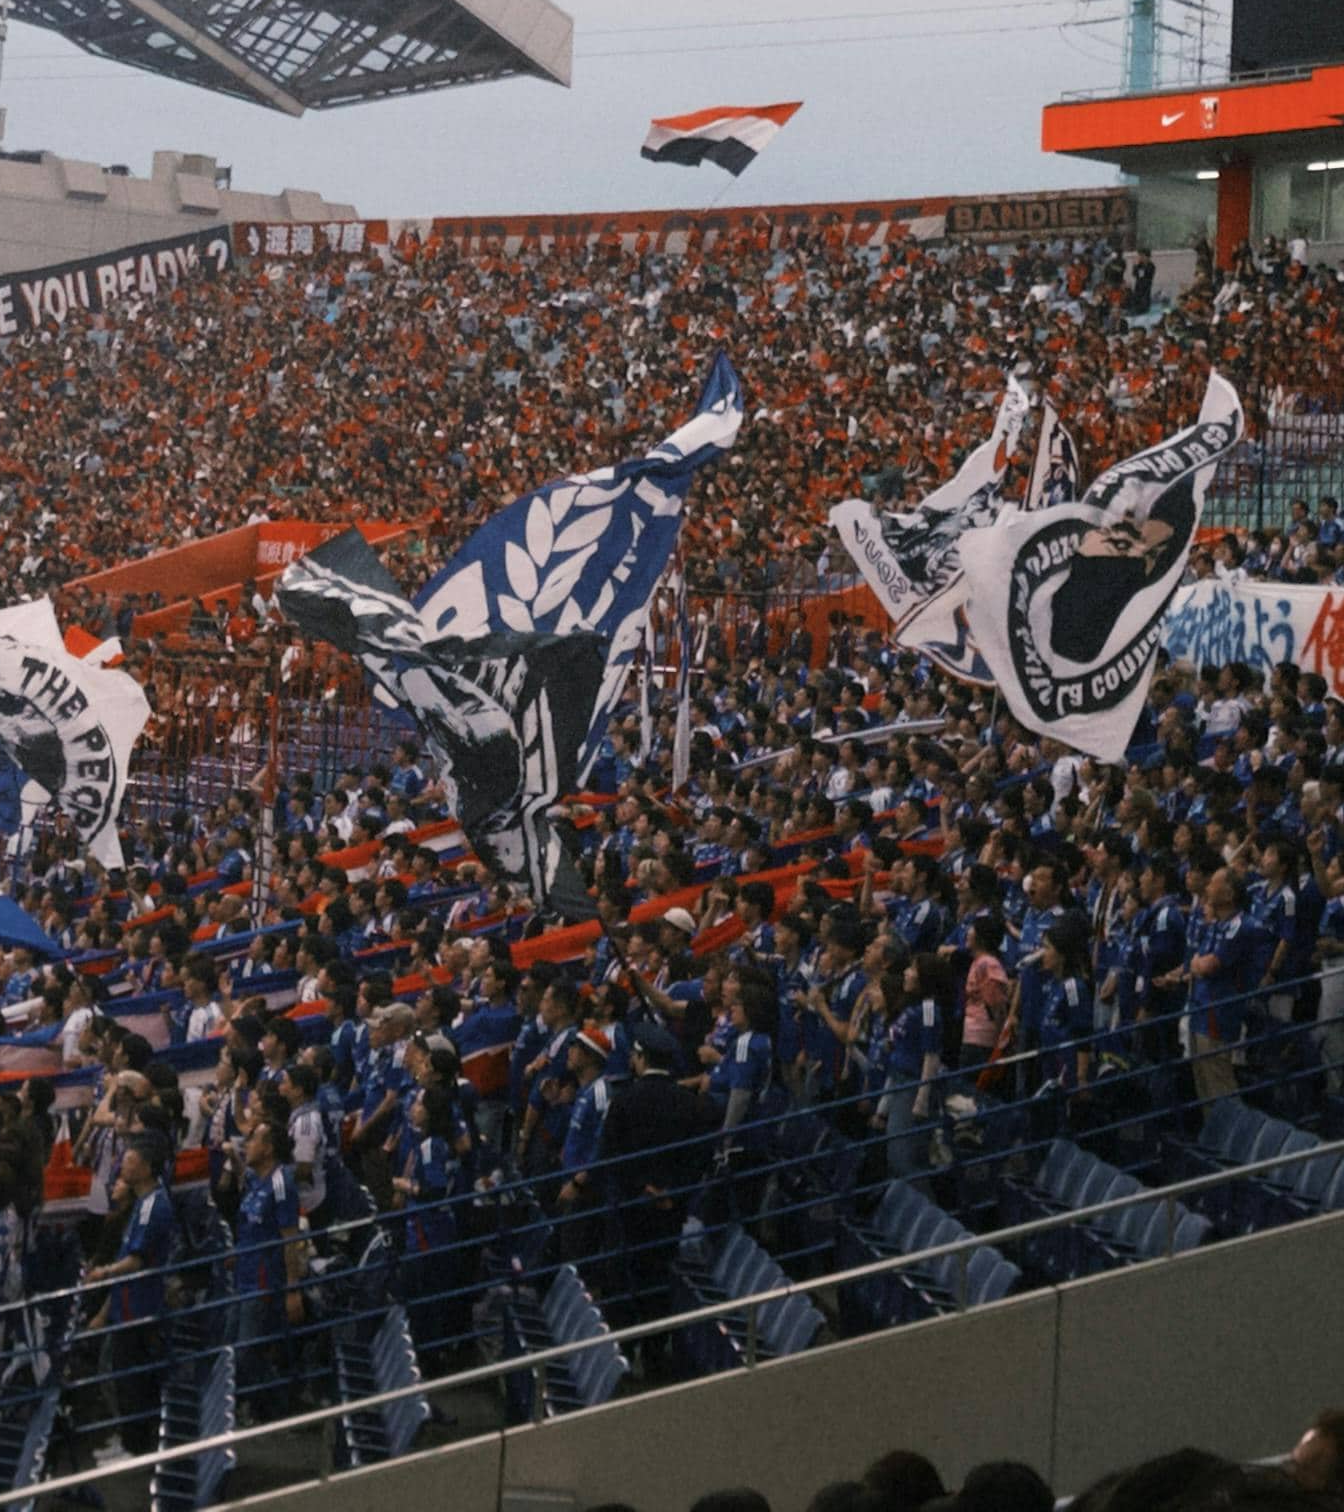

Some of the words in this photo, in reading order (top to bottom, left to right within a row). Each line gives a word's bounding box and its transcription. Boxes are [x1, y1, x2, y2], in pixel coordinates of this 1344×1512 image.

[955, 198, 1128, 231] BANDIERA
[22, 270, 90, 328] YOU
[21, 656, 89, 721] THE
[65, 727, 110, 829] PEOP
